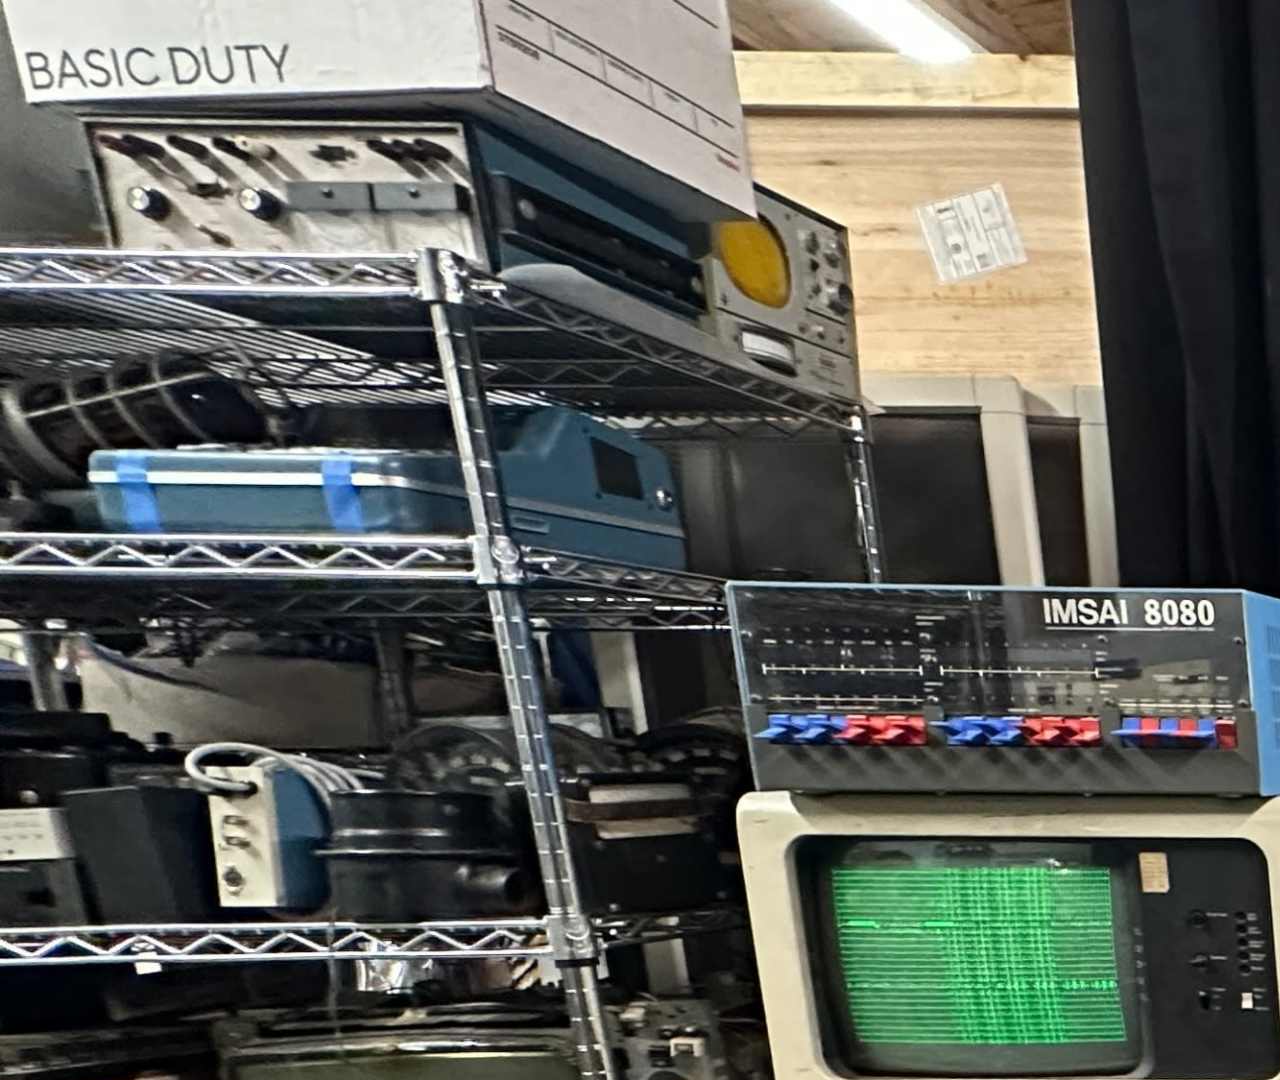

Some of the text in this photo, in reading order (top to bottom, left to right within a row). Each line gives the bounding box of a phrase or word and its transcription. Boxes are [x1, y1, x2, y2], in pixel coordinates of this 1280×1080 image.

[25, 43, 289, 90] BASIC DUTY
[1042, 598, 1215, 626] IMSAI 8080
